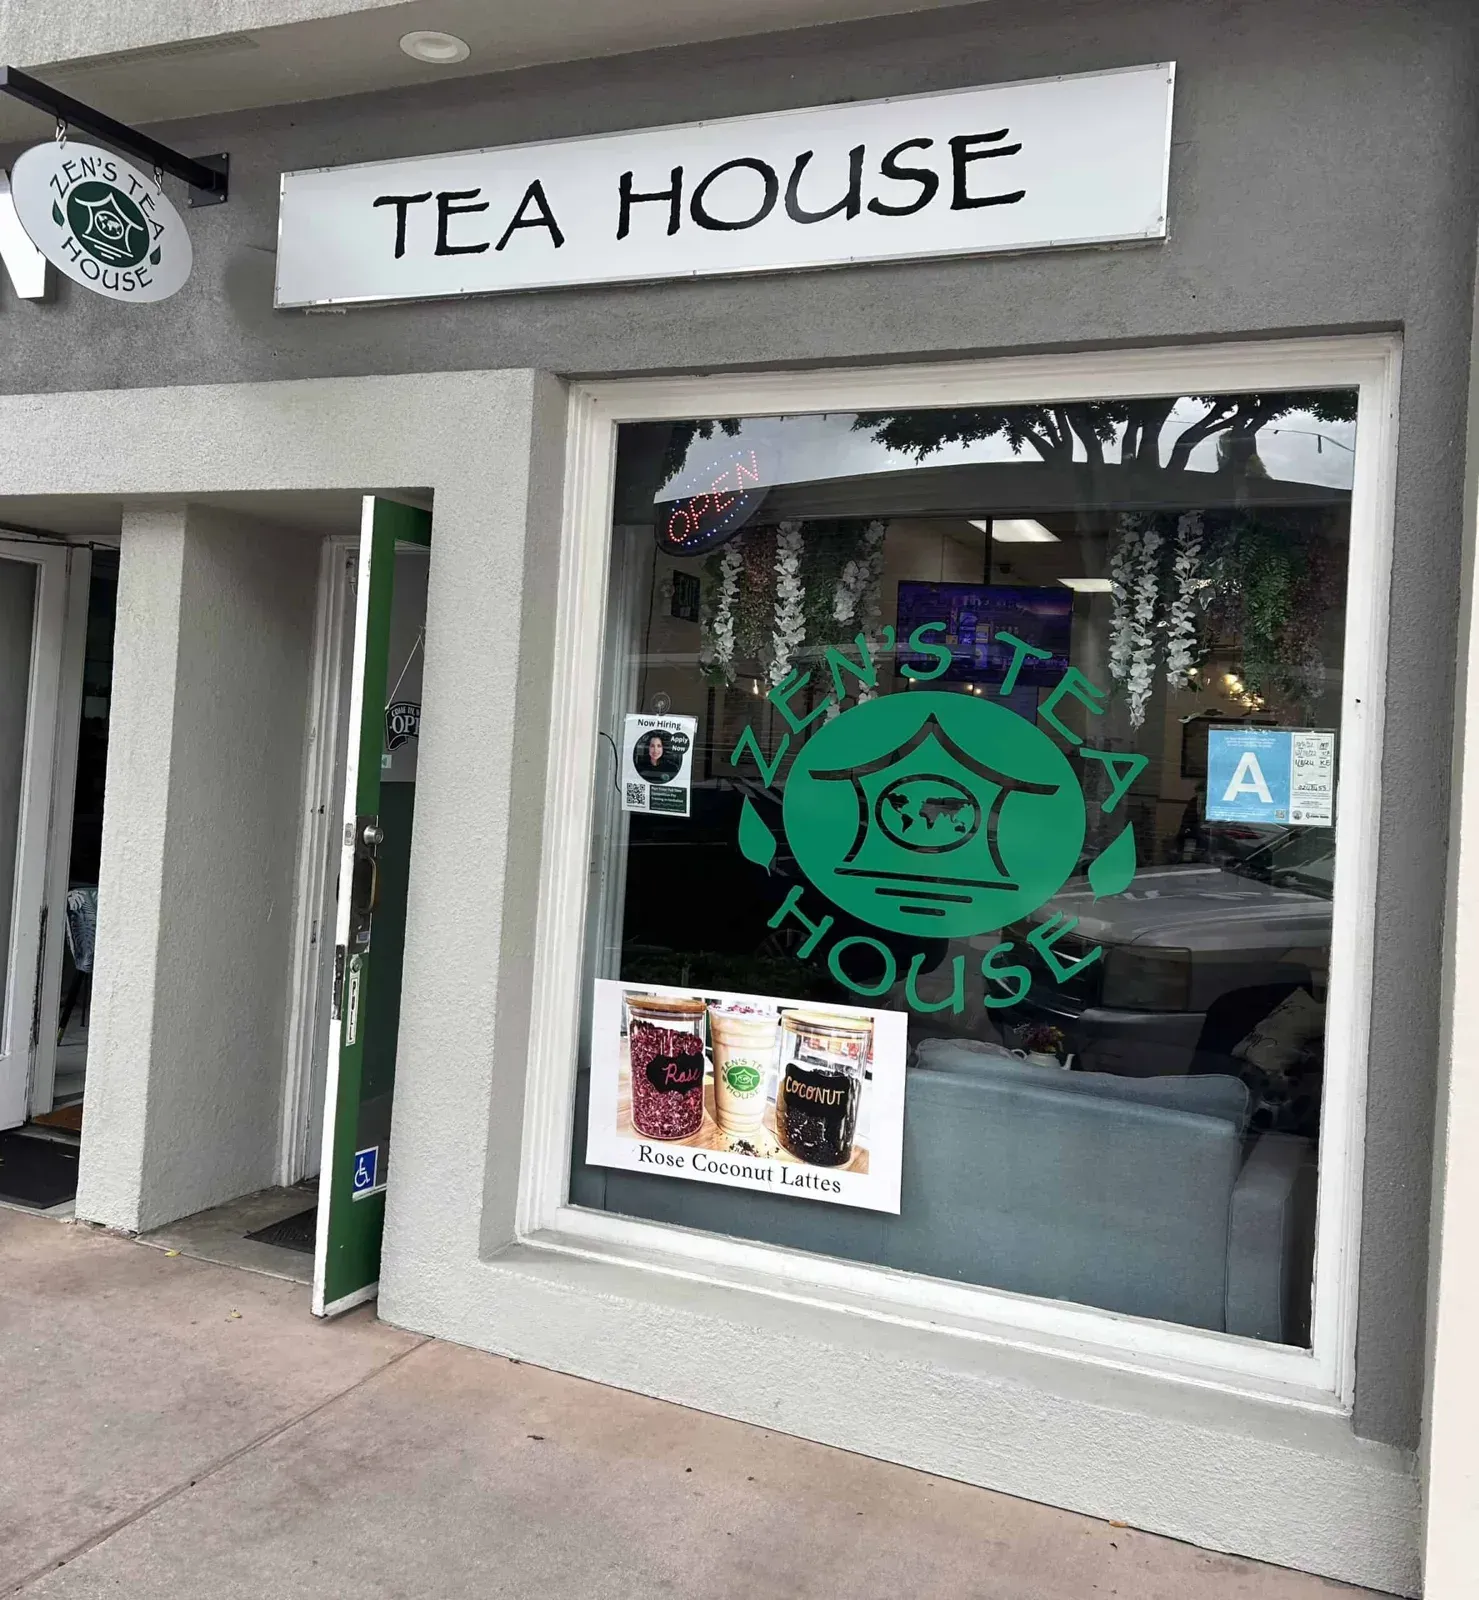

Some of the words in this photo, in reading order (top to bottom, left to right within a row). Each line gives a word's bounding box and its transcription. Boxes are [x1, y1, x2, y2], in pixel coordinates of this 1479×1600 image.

[50, 156, 118, 199] ZEN'S
[127, 173, 165, 241] TEA
[372, 179, 565, 258] TEA
[616, 128, 1026, 240] HOUSE
[61, 235, 153, 292] HOUSE
[668, 449, 760, 543] OPEN
[637, 719, 656, 728] Now
[657, 720, 681, 731] Hiring
[670, 736, 688, 744] Apply
[730, 621, 953, 788] ZEN'S
[995, 631, 1149, 813] TEA
[1222, 752, 1274, 803] A
[767, 885, 1103, 1014] HOUSE
[349, 981, 357, 1040] PULL
[661, 1063, 700, 1085] Rose
[721, 1058, 748, 1073] ZEN'S
[785, 1076, 846, 1106] COCONUT
[637, 1144, 685, 1169] Rose
[691, 1153, 774, 1183] Coconut
[779, 1165, 842, 1194] Lattes
